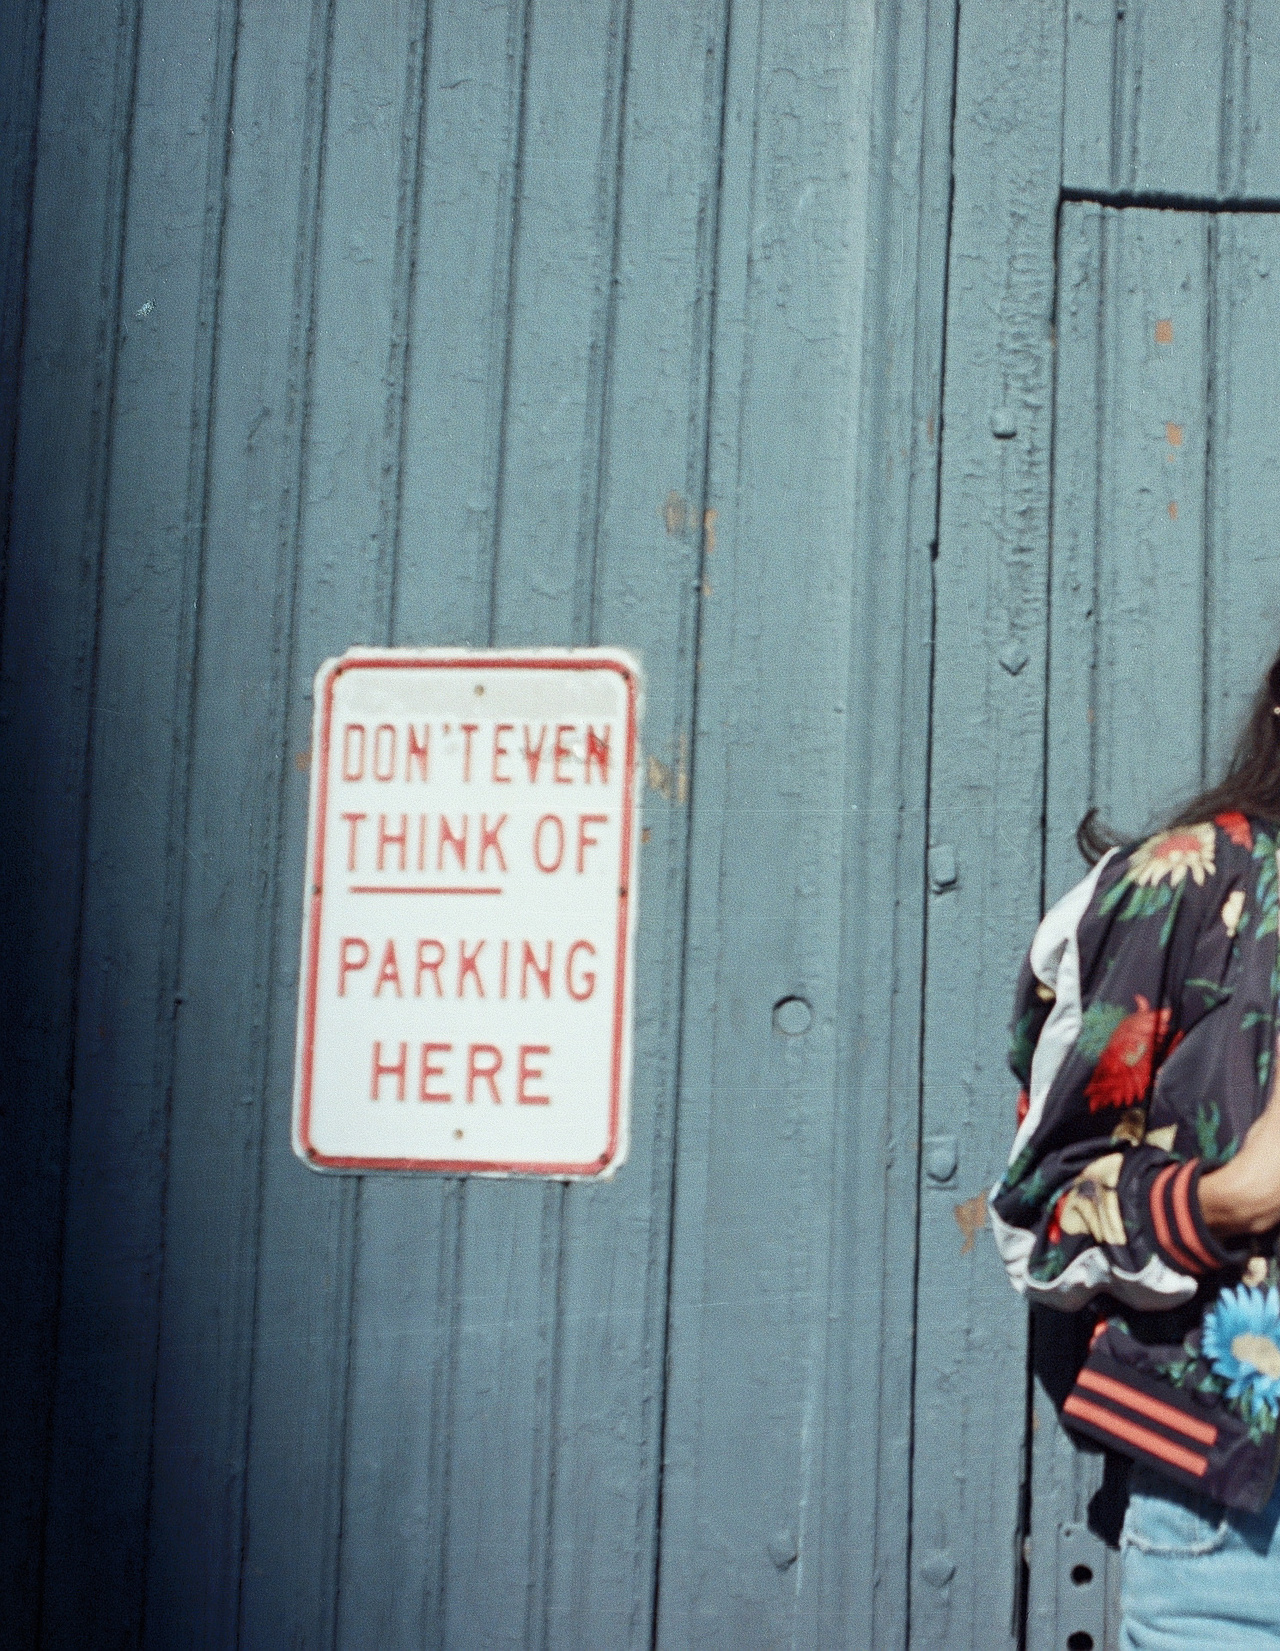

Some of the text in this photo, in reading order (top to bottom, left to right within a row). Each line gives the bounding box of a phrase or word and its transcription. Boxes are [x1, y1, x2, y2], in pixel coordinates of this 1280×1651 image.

[341, 723, 612, 784] DON'T EVEN
[340, 812, 609, 874] THINK OF
[336, 937, 597, 1002] PARKING
[369, 1041, 552, 1106] HERE
